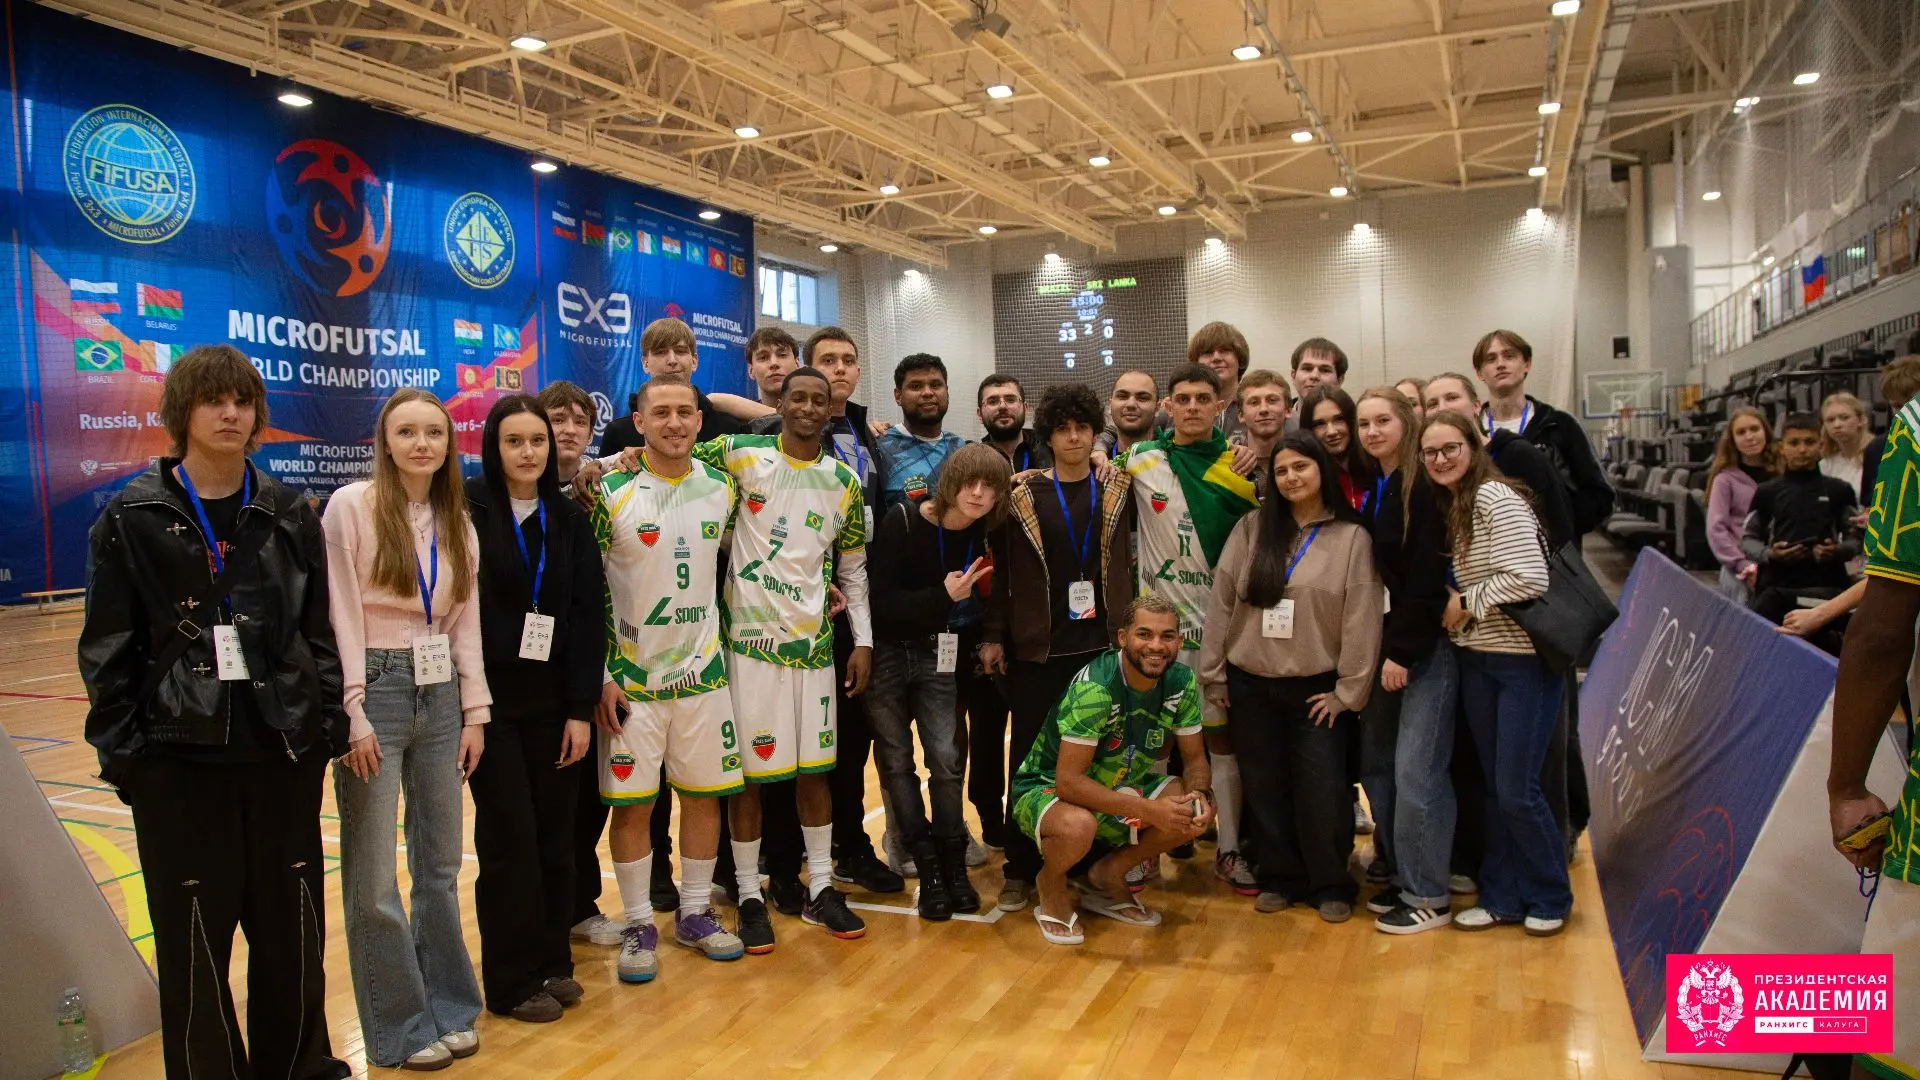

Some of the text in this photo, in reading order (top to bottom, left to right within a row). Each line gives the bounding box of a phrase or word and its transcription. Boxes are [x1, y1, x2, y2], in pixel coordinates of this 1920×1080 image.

[170, 145, 190, 177] FUTSAL
[89, 159, 174, 193] FIFUSA
[108, 221, 161, 238] MICROFUTSAL
[1086, 277, 1137, 290] SRI LANKA
[146, 320, 177, 331] BELARUS
[693, 312, 742, 333] MICROFUTSAL
[1084, 323, 1093, 335] 2
[228, 309, 426, 356] MICROFUTSAL
[560, 331, 632, 348] MICROFUTSAL
[693, 327, 714, 338] WORLD
[714, 330, 749, 345] CHAMPIONSHIP
[1059, 328, 1077, 342] 33
[1104, 326, 1114, 338] 0
[1066, 358, 1075, 368] 0
[1104, 355, 1113, 365] 0
[88, 376, 114, 384] BRAZIL
[251, 357, 440, 389] RLD CHAMPIONSHIP
[79, 411, 142, 430] Russia,
[300, 444, 374, 458] MICROFUTSA
[269, 459, 373, 473] WORLD CHAMPIO
[767, 539, 783, 561] 7
[0, 568, 12, 581] IA
[677, 563, 690, 589] 9
[675, 606, 709, 624] sport
[821, 697, 830, 727] 7
[721, 720, 736, 749] 9
